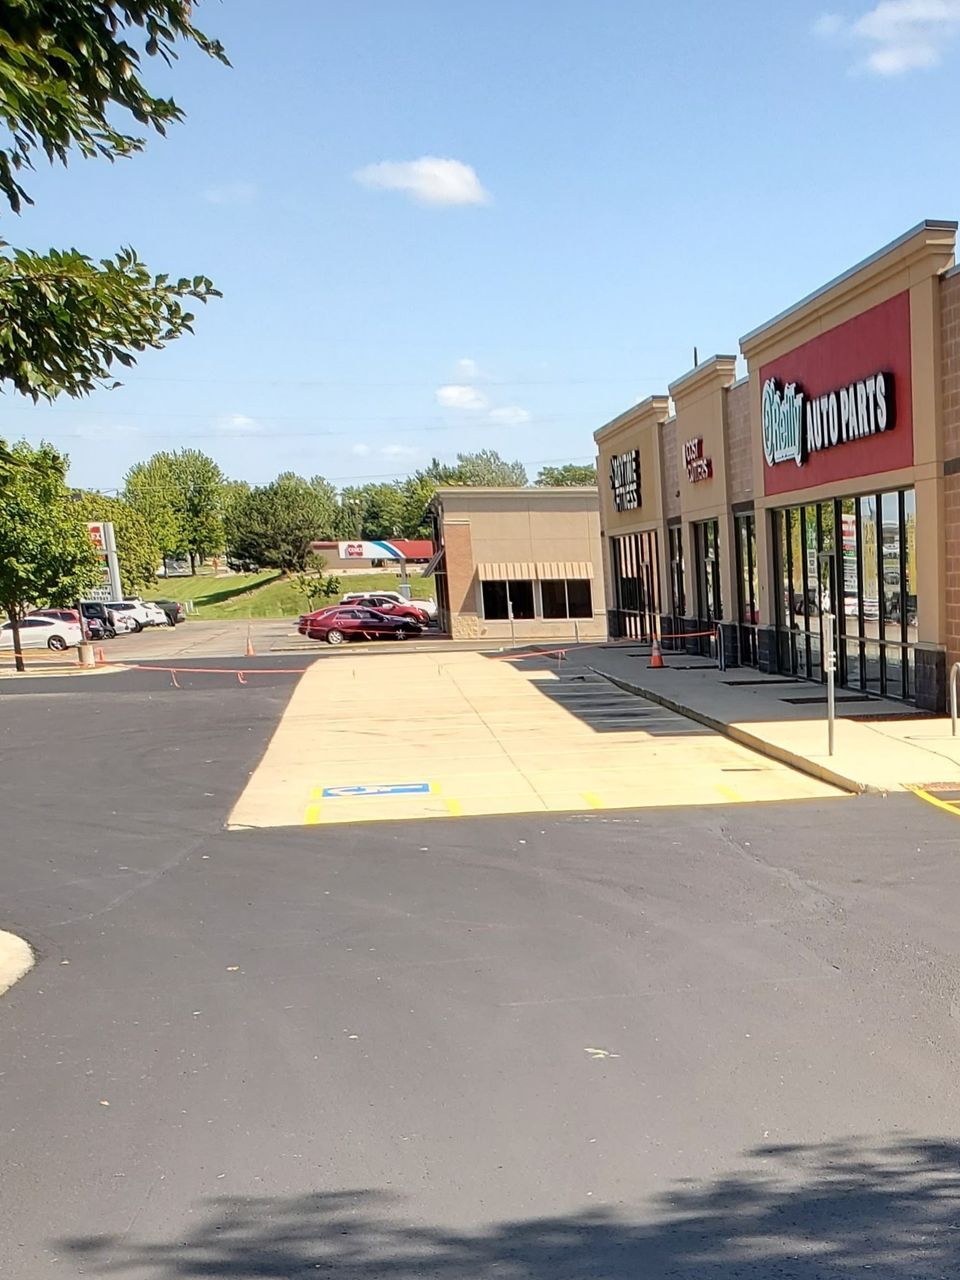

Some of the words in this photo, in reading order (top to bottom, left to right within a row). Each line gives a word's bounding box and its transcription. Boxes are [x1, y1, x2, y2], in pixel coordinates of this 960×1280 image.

[762, 377, 803, 467] O'Reilly
[806, 391, 838, 453] AUTO
[840, 372, 887, 442] PARTS
